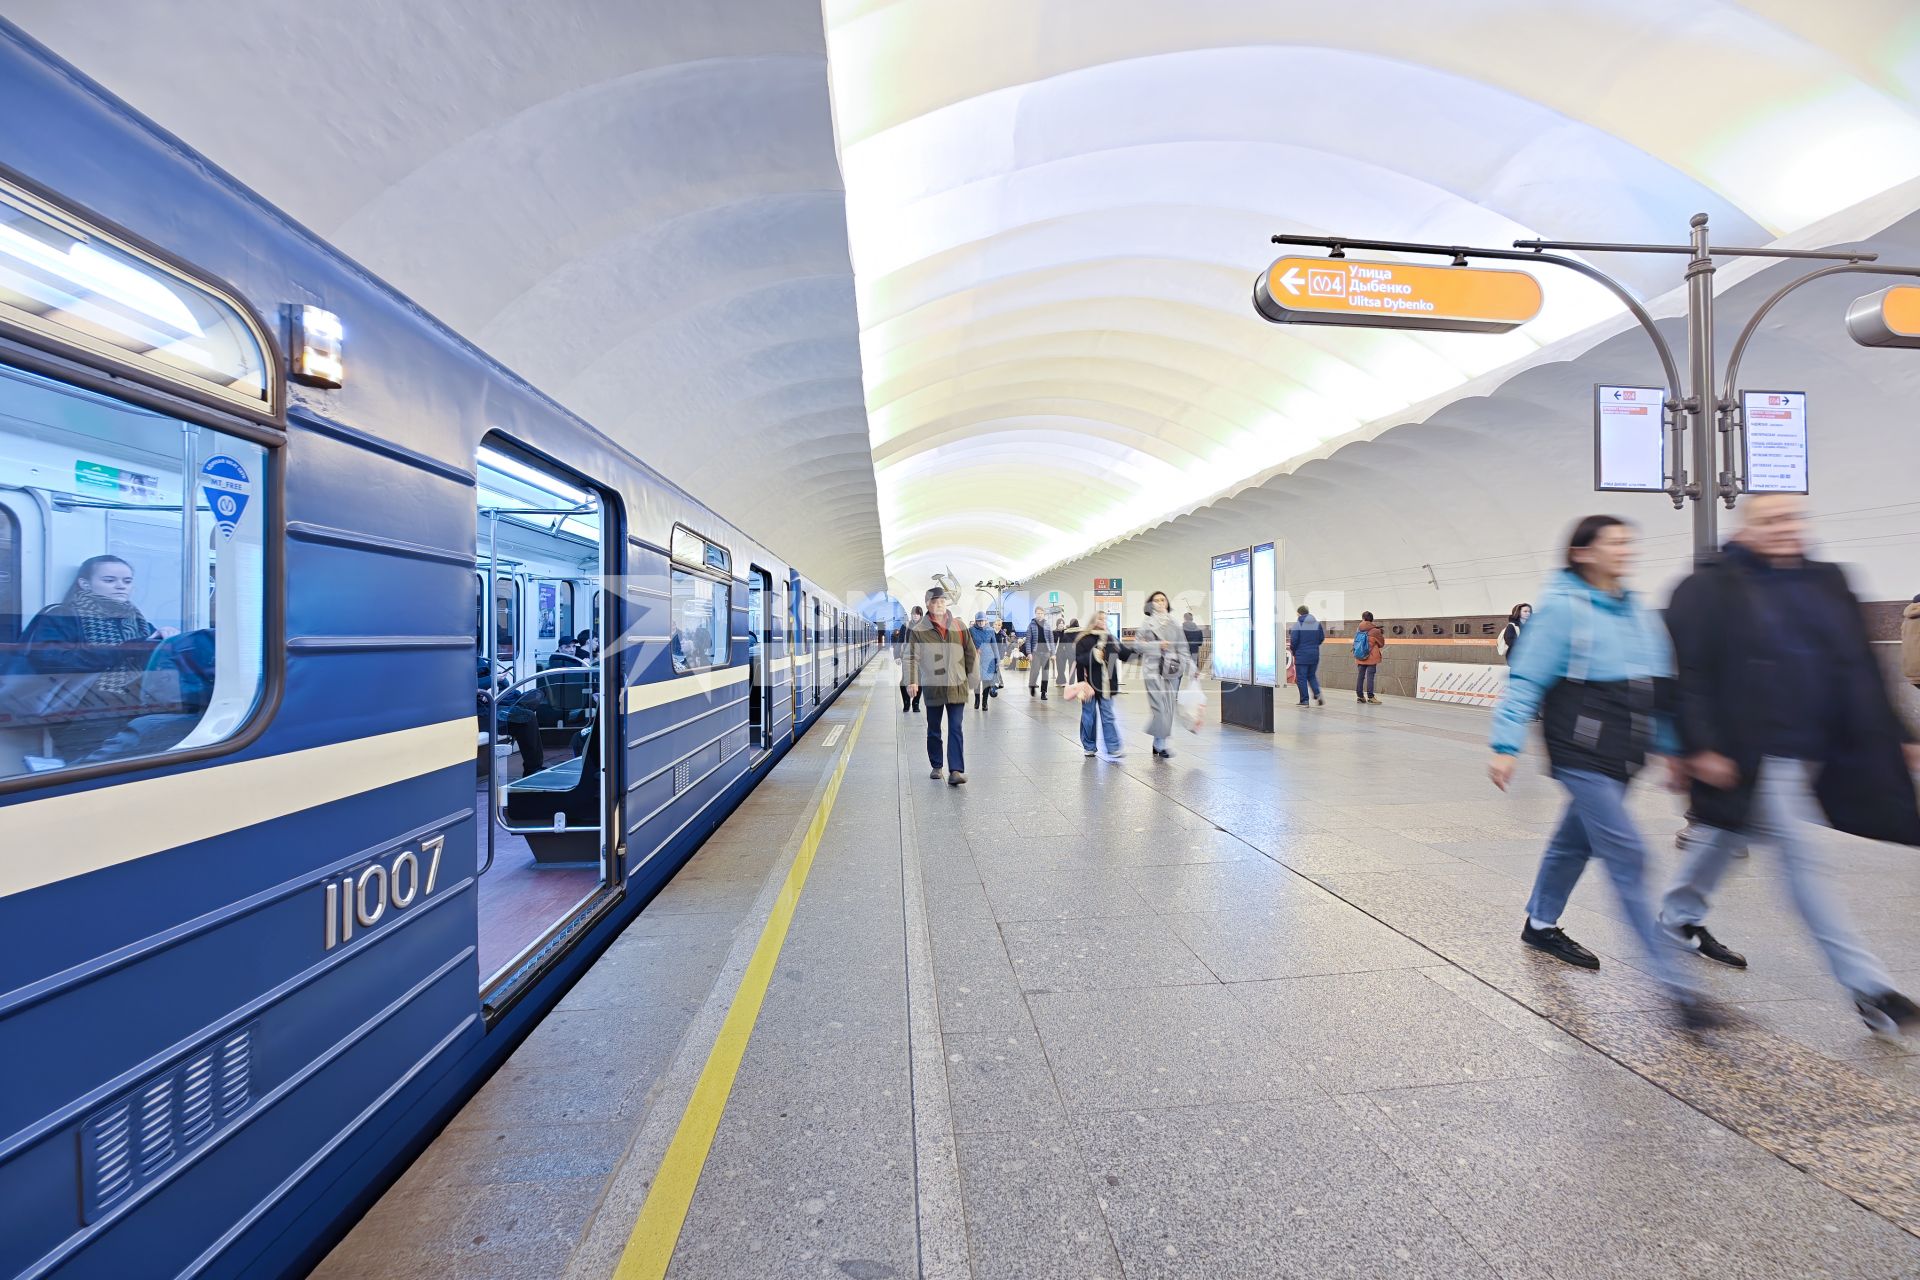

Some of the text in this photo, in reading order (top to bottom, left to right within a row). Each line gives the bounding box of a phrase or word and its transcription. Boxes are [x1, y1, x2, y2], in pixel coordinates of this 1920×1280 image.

[1349, 265, 1392, 280] Улица
[1349, 279, 1412, 293] Дыбенко
[1348, 295, 1434, 311] Ulitsa Dybenko
[211, 479, 242, 490] MT_FREE
[326, 834, 444, 950] 11007
